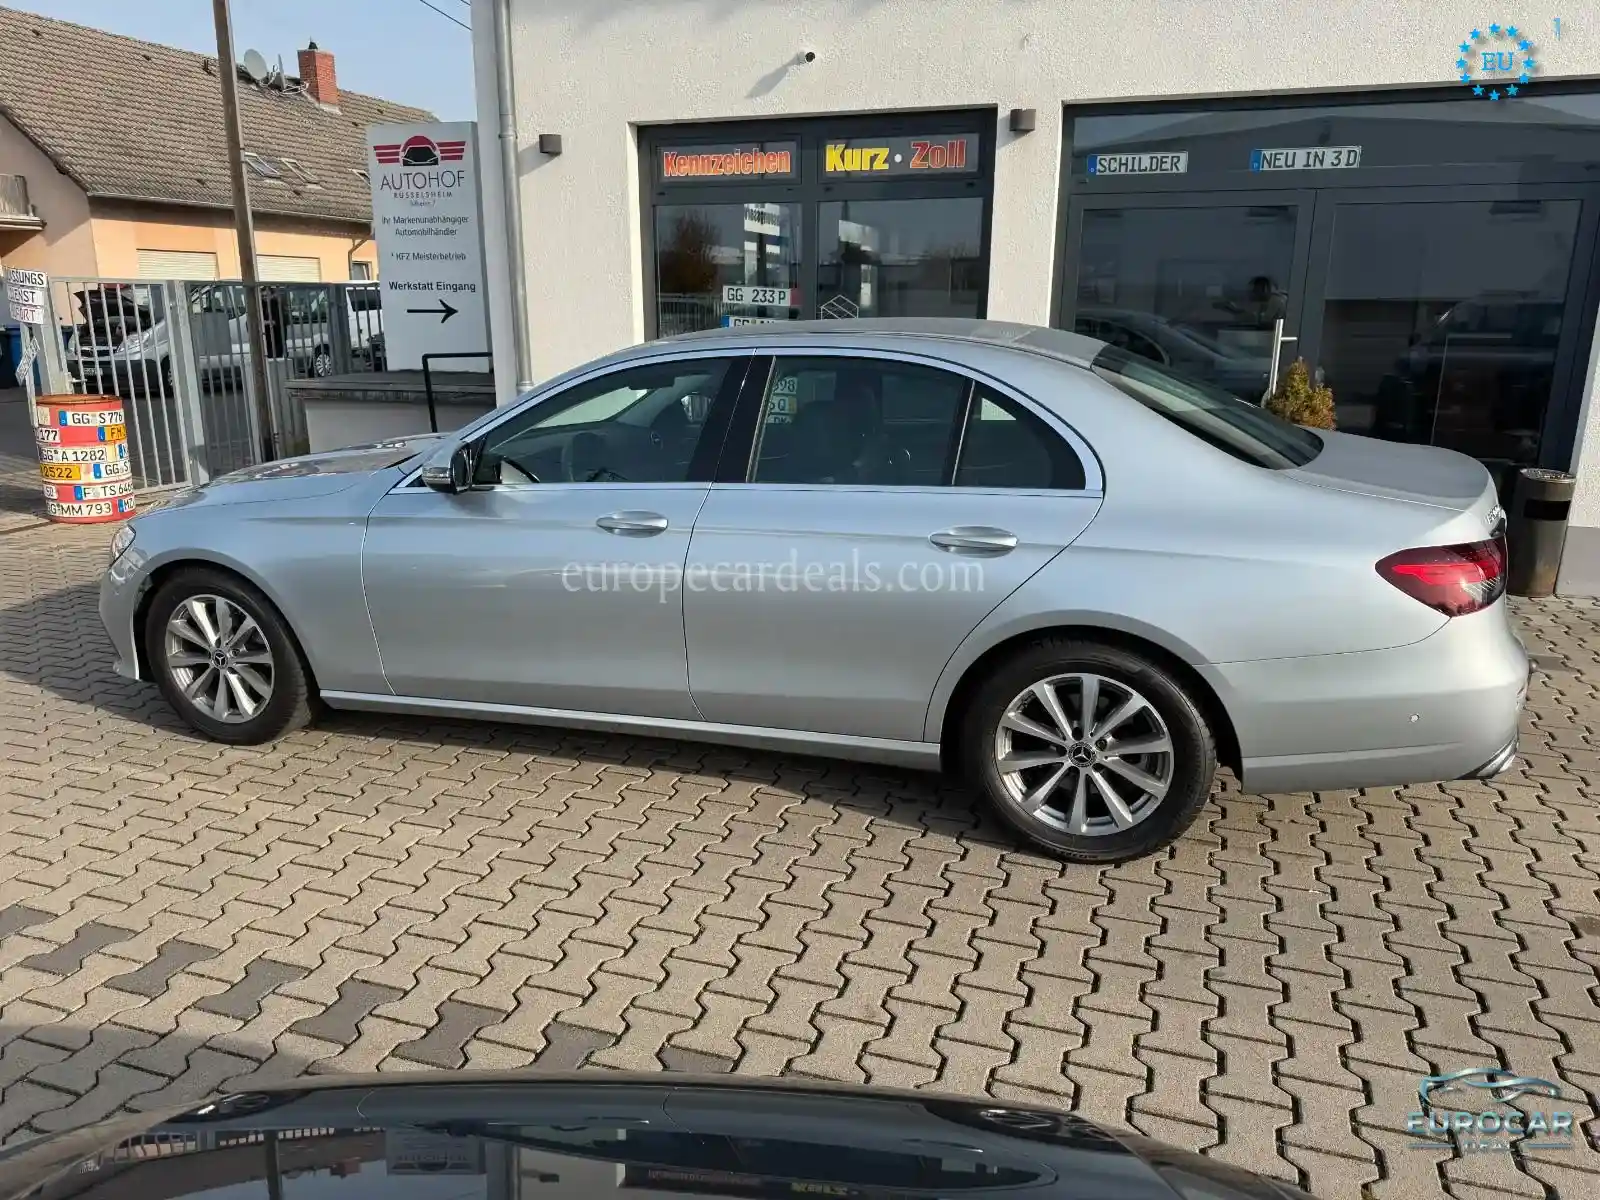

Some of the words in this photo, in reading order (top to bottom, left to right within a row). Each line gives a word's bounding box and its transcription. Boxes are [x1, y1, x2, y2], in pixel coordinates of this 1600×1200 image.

[663, 147, 792, 177] Kennzeichen
[825, 143, 890, 173] Kurz
[909, 138, 967, 169] Zoll
[1260, 151, 1297, 169] NEU
[1302, 150, 1326, 168] IN
[1097, 155, 1181, 173] SCHILDER
[379, 170, 465, 191] AUTOHOF
[395, 227, 458, 236] Automobilhändler
[396, 252, 410, 261] KFZ
[412, 252, 467, 261] Meisterbetrieb
[389, 281, 434, 291] Werkstatt
[436, 281, 476, 293] Eingang
[727, 287, 744, 301] GG
[751, 288, 775, 303] 233
[778, 289, 786, 304] P
[72, 412, 90, 424] GG
[99, 412, 106, 424] S
[61, 450, 69, 461] A
[72, 449, 105, 462] 1282
[104, 463, 120, 476] GG
[100, 485, 117, 497] TS
[86, 502, 112, 516] 793
